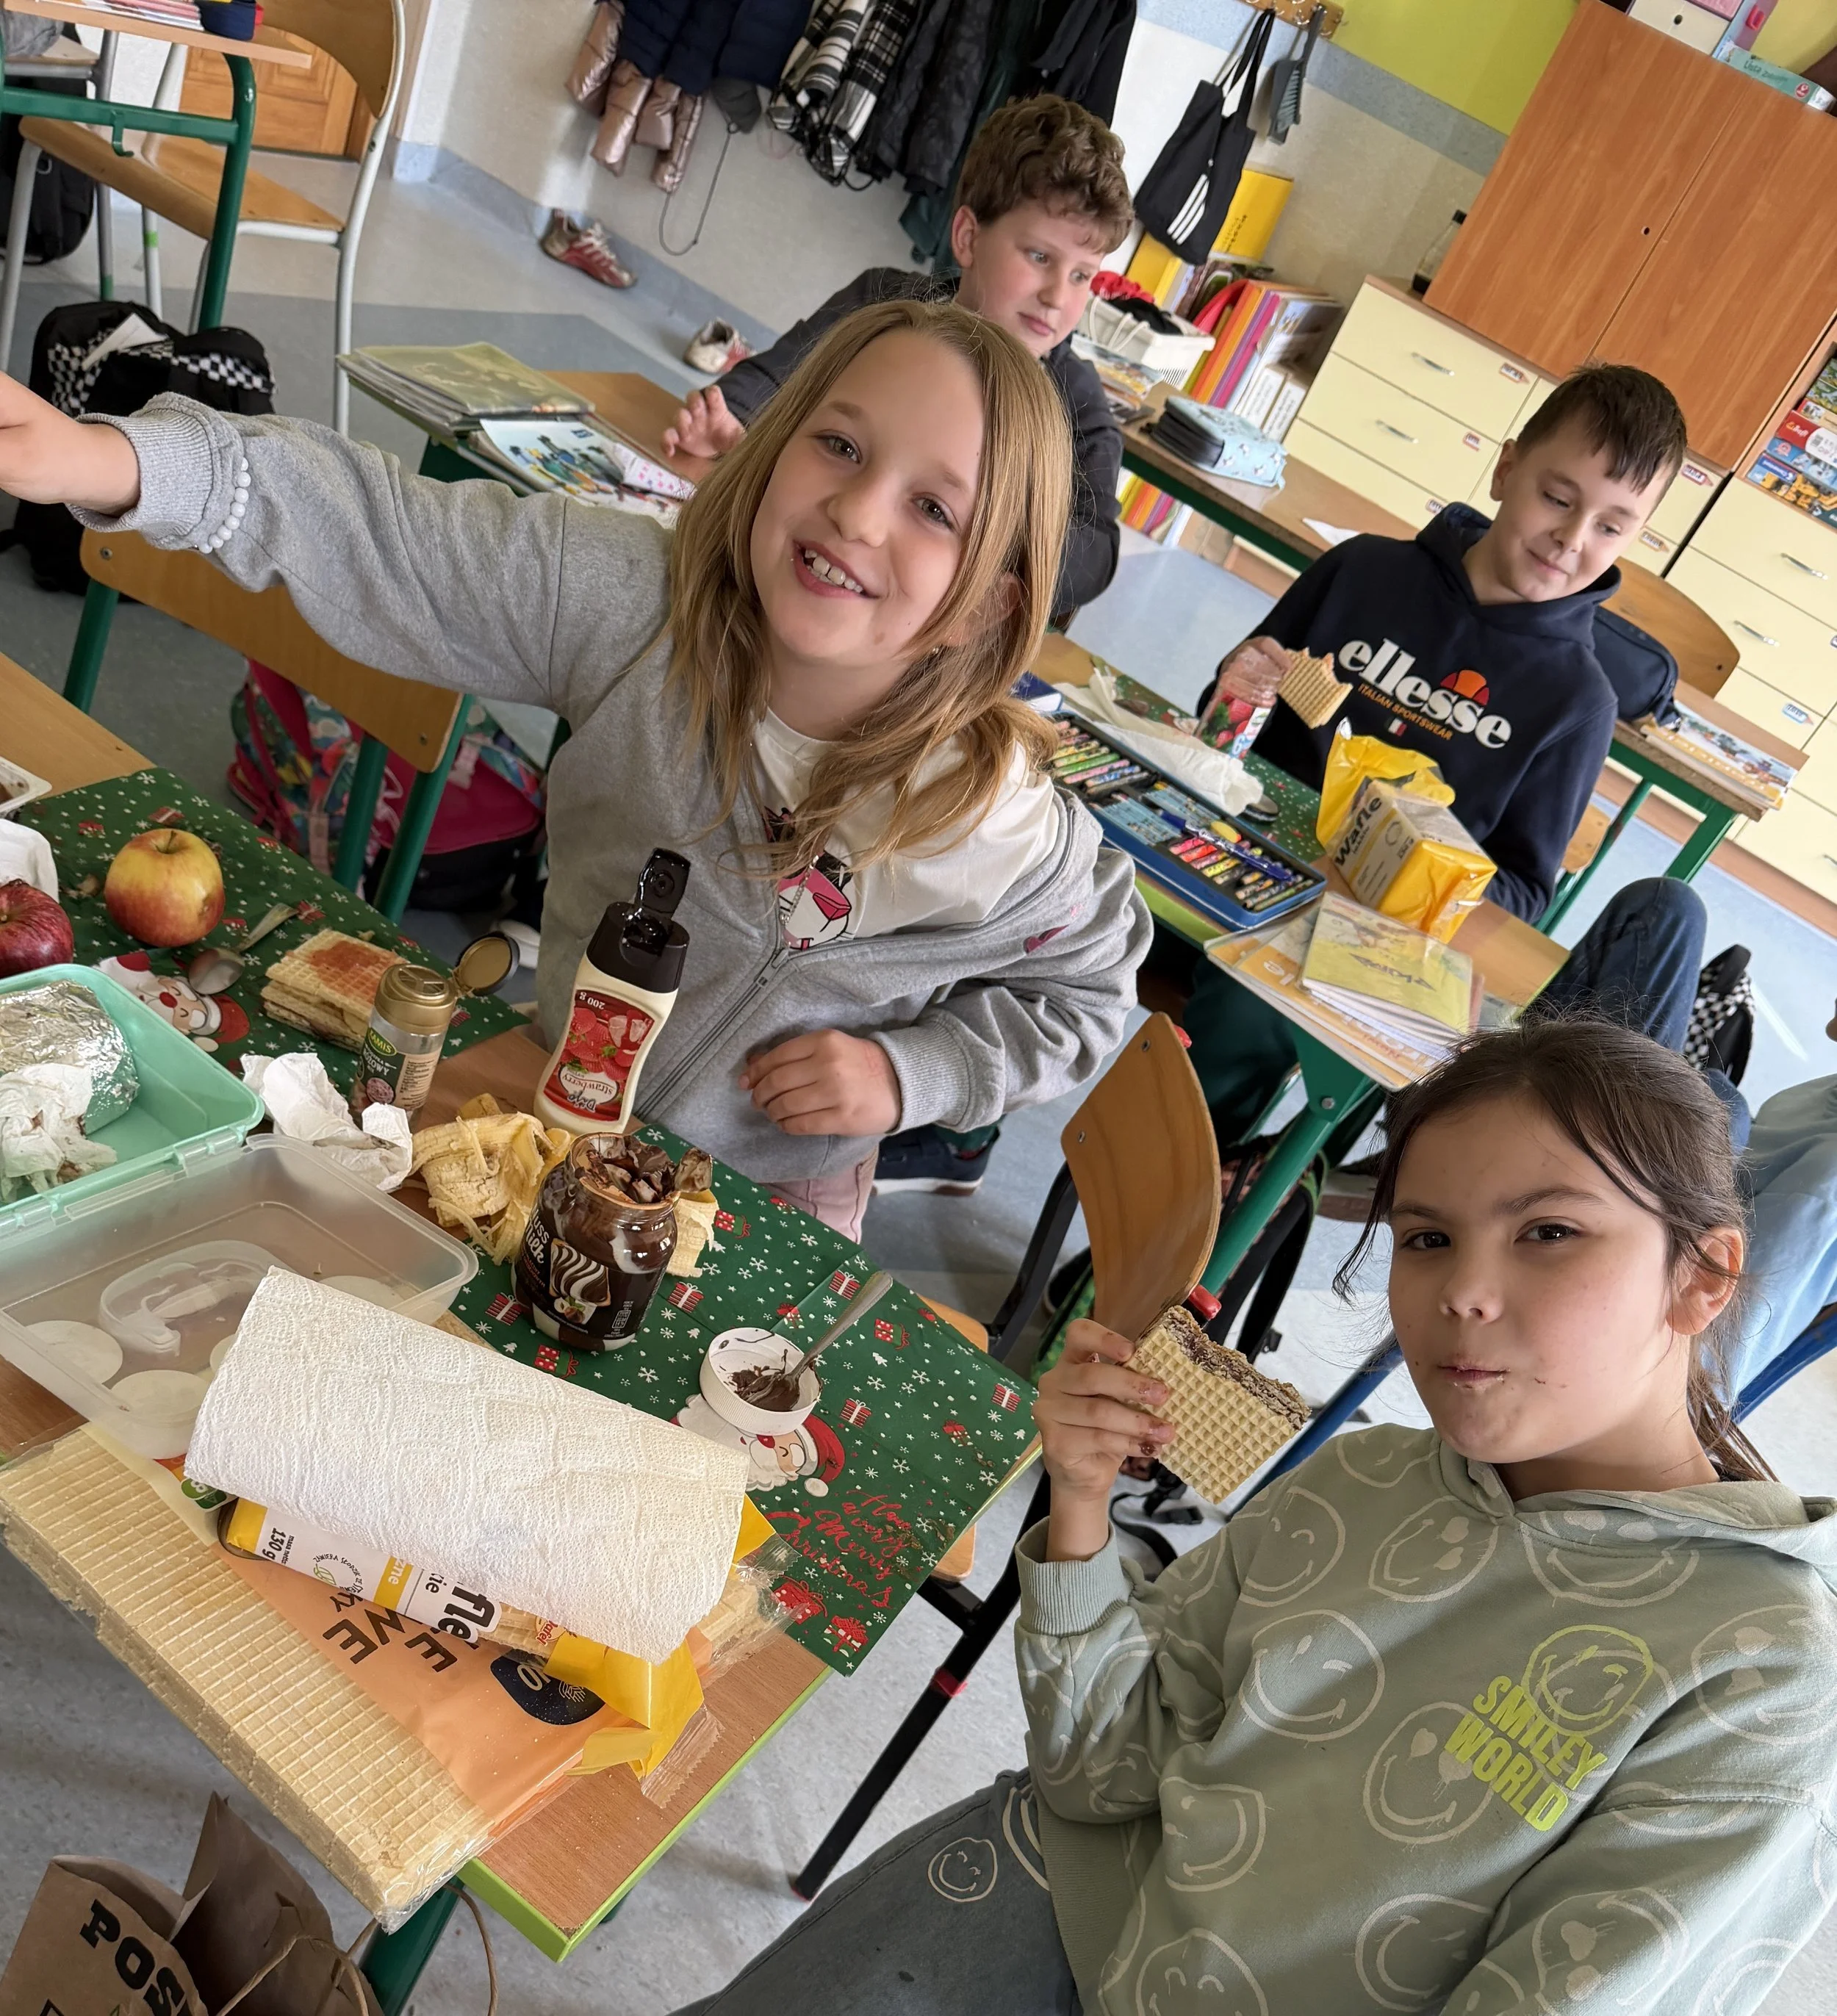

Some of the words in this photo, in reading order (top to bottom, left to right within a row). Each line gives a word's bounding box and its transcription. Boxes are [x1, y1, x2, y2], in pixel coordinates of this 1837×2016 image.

[1338, 638, 1511, 749] ellesse
[1359, 683, 1391, 709] ITALIAN
[1393, 704, 1454, 741] SPORTSWEAR
[578, 991, 587, 1001] g
[587, 998, 605, 1010] 200
[562, 1072, 614, 1095] strawberry
[567, 1090, 597, 1112] Dijo
[269, 1527, 286, 1552] 130
[286, 1536, 295, 1551] masa
[814, 1511, 894, 1580] Merry
[262, 1548, 276, 1560] g
[313, 1553, 339, 1563] ZAWIERA
[322, 1608, 406, 1665] NE
[1473, 1675, 1608, 1790] SMILEY
[1445, 1713, 1569, 1832] WORLD
[79, 1898, 193, 2016] POS
